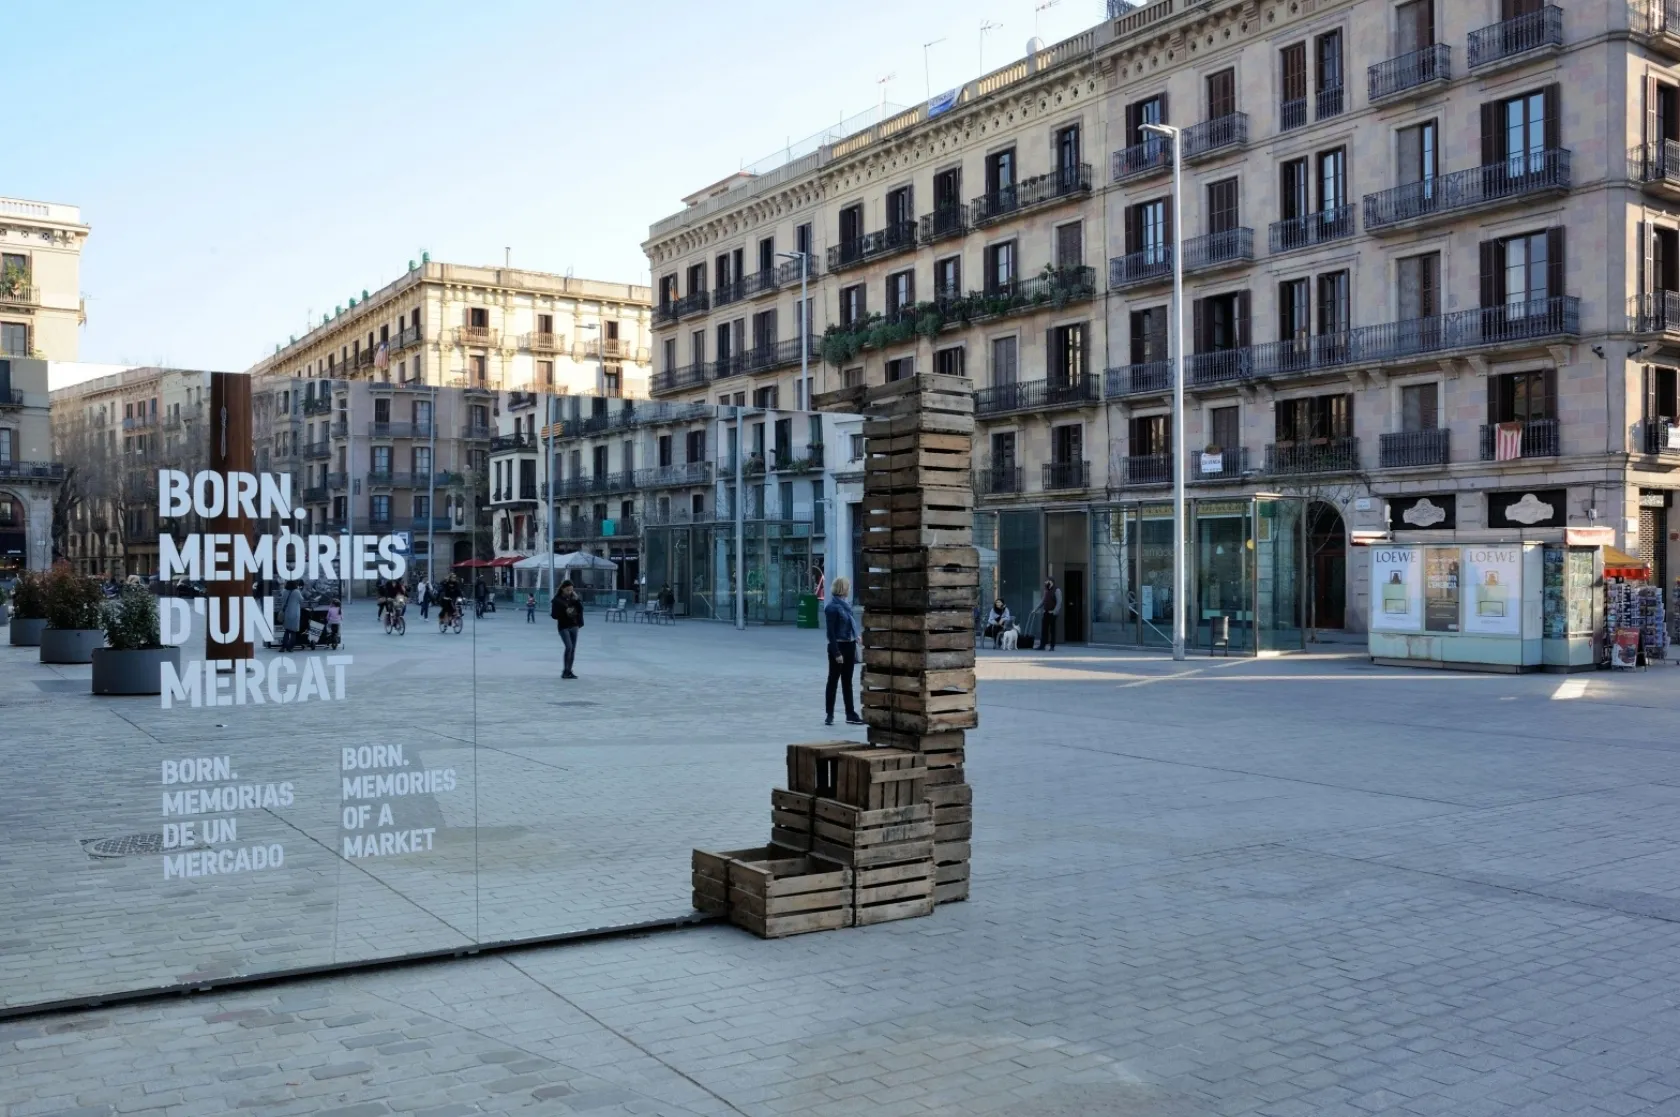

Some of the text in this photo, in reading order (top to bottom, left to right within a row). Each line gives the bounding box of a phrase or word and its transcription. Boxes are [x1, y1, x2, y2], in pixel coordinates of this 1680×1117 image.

[159, 469, 307, 519] BORN.
[159, 525, 406, 581] MEMÒRIES
[1376, 551, 1417, 563] LOEWE
[1469, 551, 1516, 563] LOEWE
[160, 596, 274, 646] D'UN
[160, 655, 353, 709] MERCAT
[161, 756, 238, 785] BORN.
[342, 744, 410, 770] BORN.
[162, 782, 294, 816] MEMORIAS
[342, 768, 457, 800] MEMORIES
[343, 803, 394, 830] OF A
[163, 818, 237, 849] DE UN
[343, 828, 436, 859] MARKET
[163, 844, 284, 880] MERCADO
